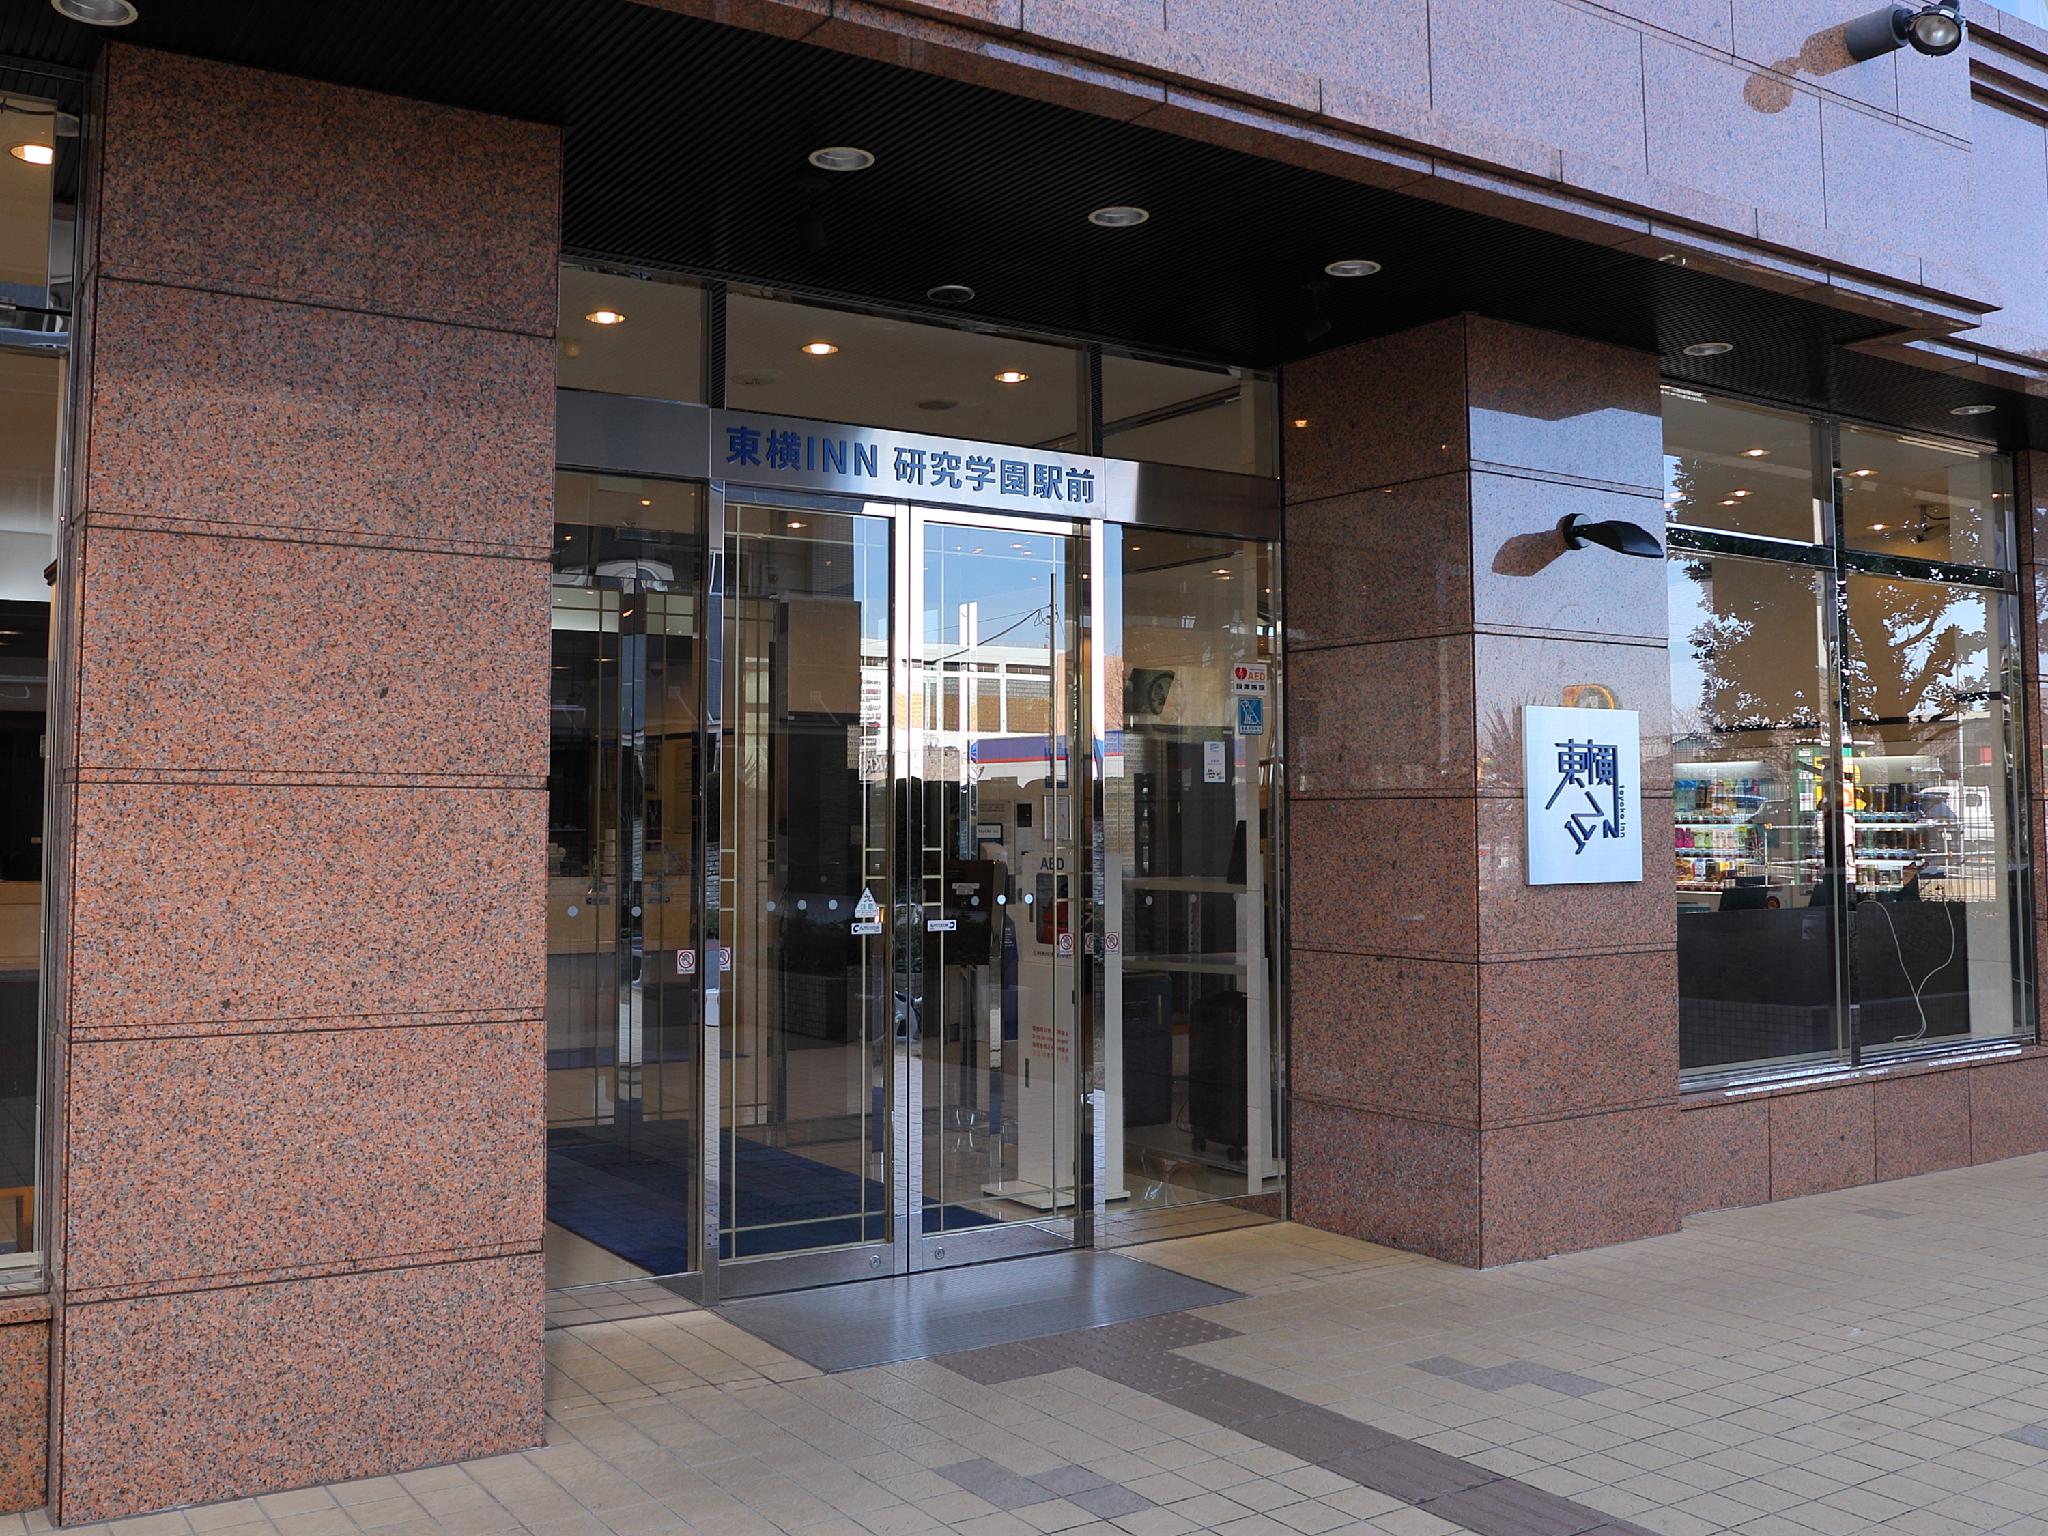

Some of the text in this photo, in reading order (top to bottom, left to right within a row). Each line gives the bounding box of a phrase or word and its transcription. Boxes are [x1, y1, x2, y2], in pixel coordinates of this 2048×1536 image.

[725, 425, 1096, 504] 東横INN 研究学園駅前
[1248, 672, 1265, 681] AED
